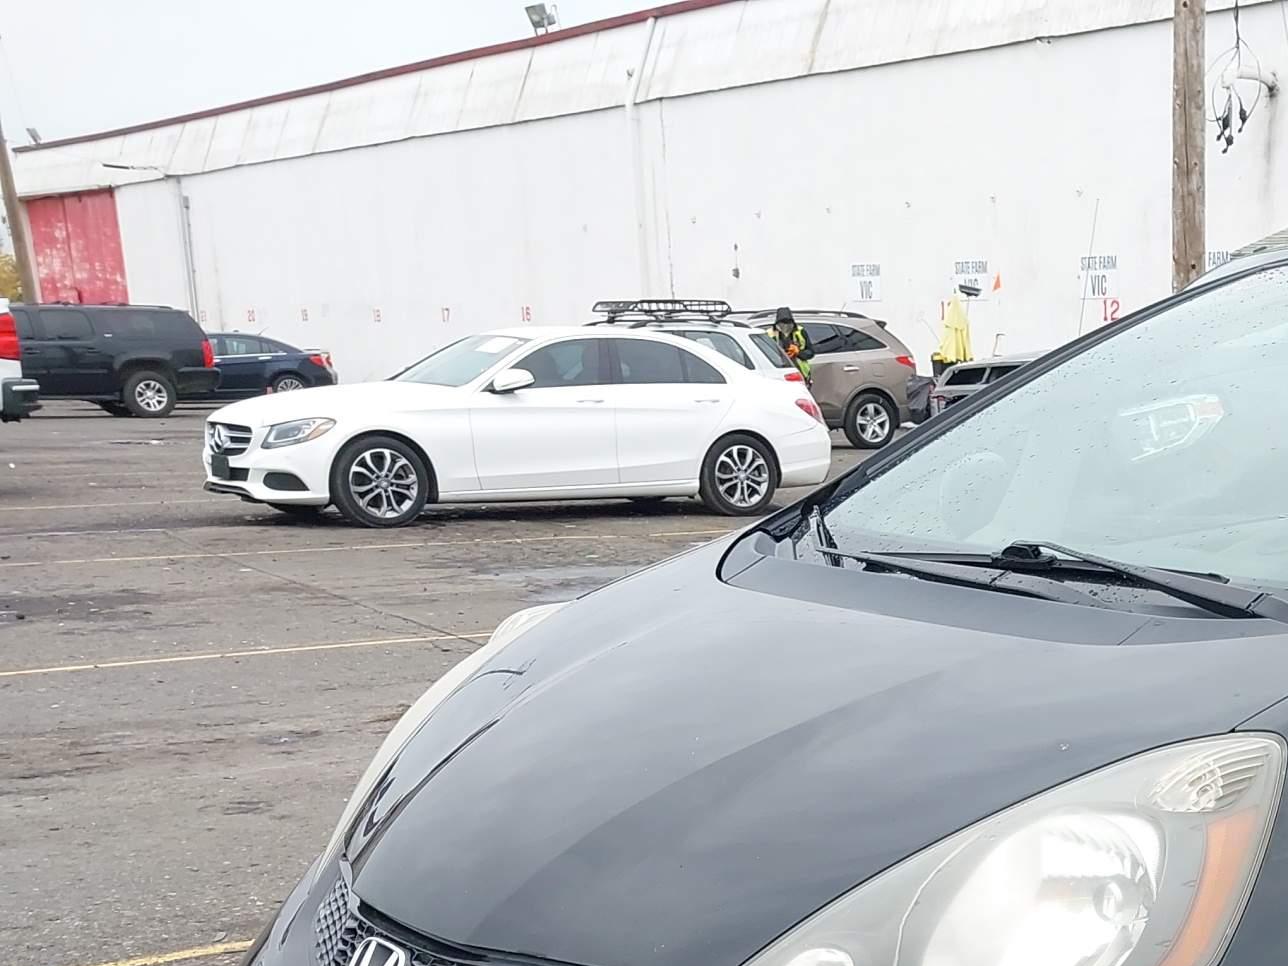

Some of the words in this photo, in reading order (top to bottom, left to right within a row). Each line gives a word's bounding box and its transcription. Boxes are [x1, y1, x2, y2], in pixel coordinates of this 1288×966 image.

[1081, 257, 1097, 271] STATE
[1099, 256, 1117, 270] FARM
[1208, 251, 1229, 267] FARM
[851, 264, 865, 277] STATE
[866, 264, 880, 277] FARM
[955, 261, 970, 274] STATE
[972, 261, 988, 274] FARM
[860, 280, 873, 299] VIC
[1090, 275, 1107, 296] VIC
[441, 307, 450, 322] 17
[521, 306, 531, 322] 16
[1103, 300, 1120, 321] 12
